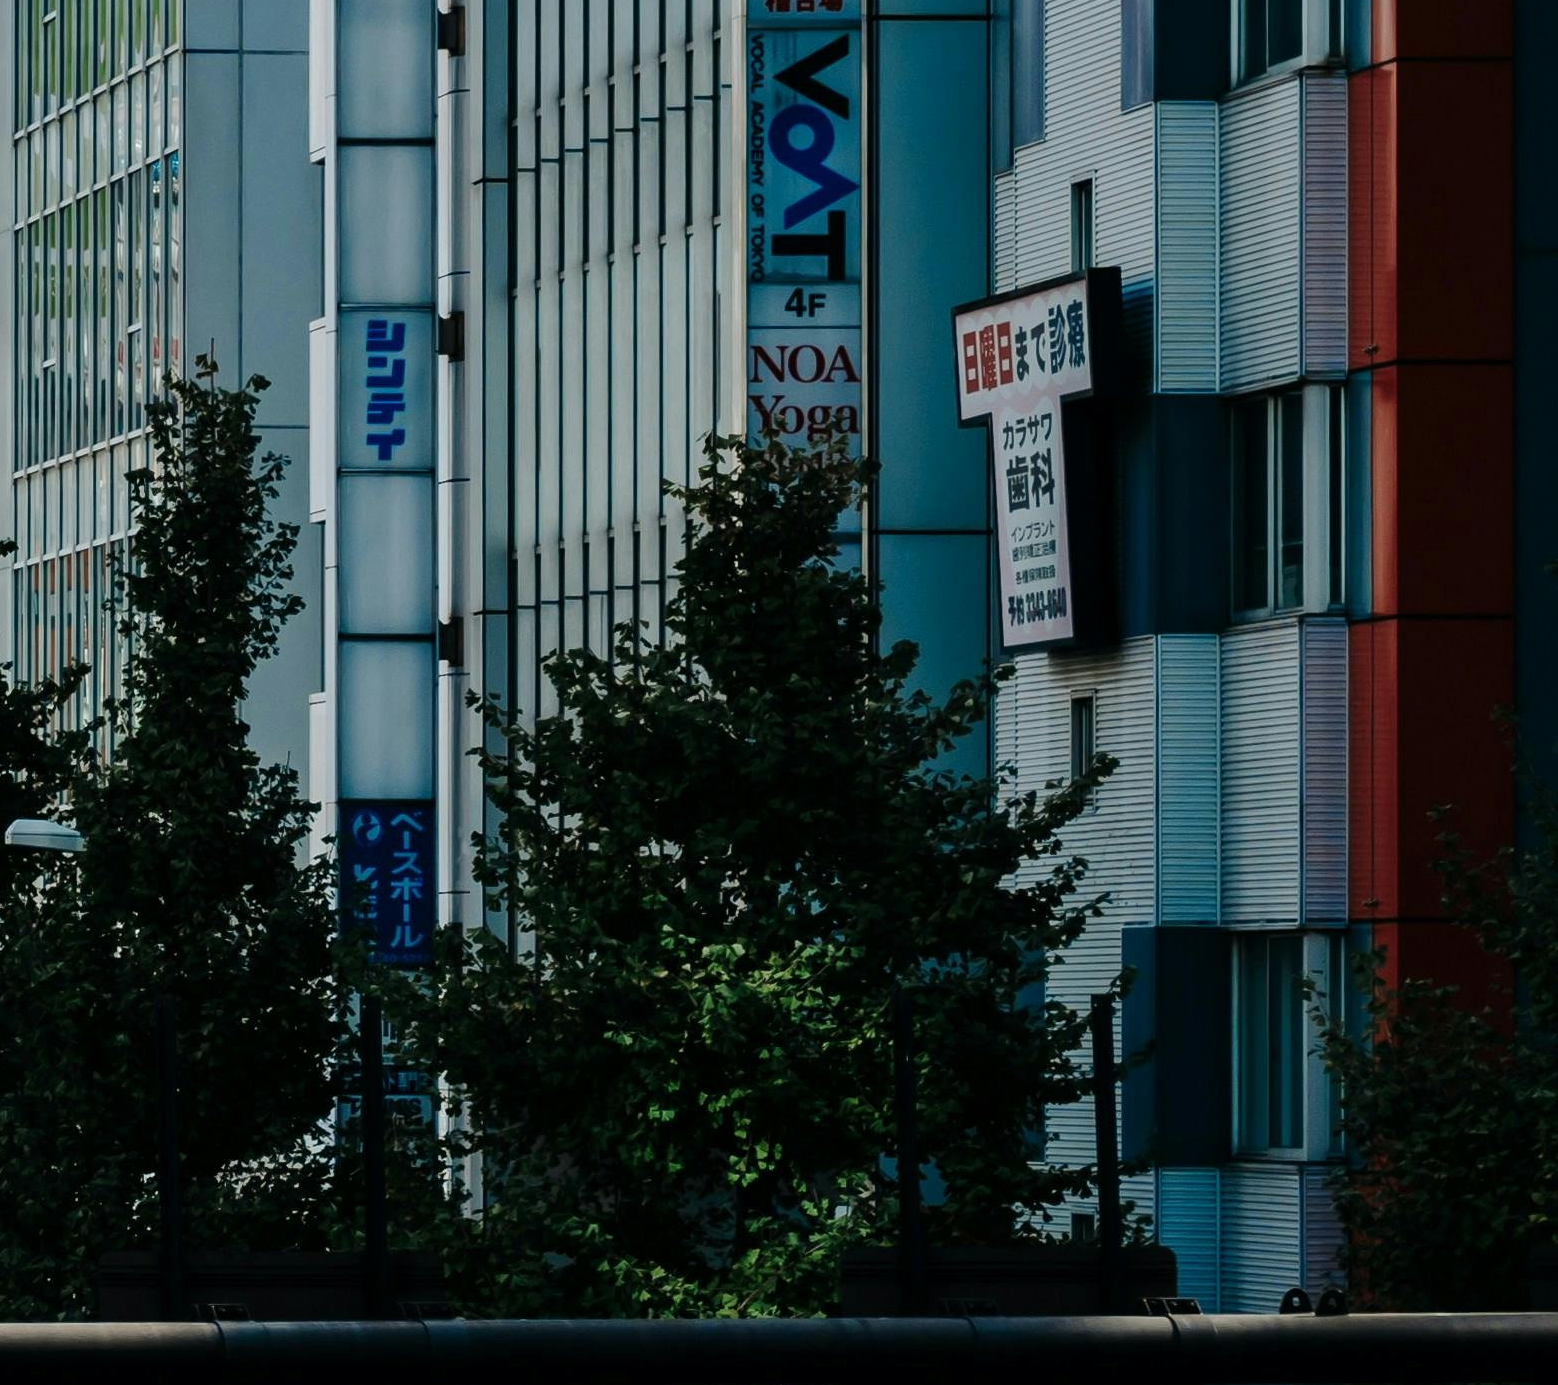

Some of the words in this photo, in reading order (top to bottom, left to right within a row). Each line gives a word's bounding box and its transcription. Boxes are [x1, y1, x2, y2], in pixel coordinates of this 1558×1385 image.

[750, 34, 766, 94] VOCAL
[750, 101, 766, 188] ACADEMY
[750, 192, 766, 219] OF
[750, 224, 766, 283] TOKYO
[783, 287, 827, 318] 4F
[751, 345, 861, 385] NOA
[961, 296, 1089, 395] 日曜日まで診療
[748, 394, 861, 443] Yoga
[1002, 412, 1054, 452] カラサワ
[1005, 447, 1056, 514] 歯科
[1010, 518, 1056, 544] インプラント
[389, 810, 425, 949] ベースボール
